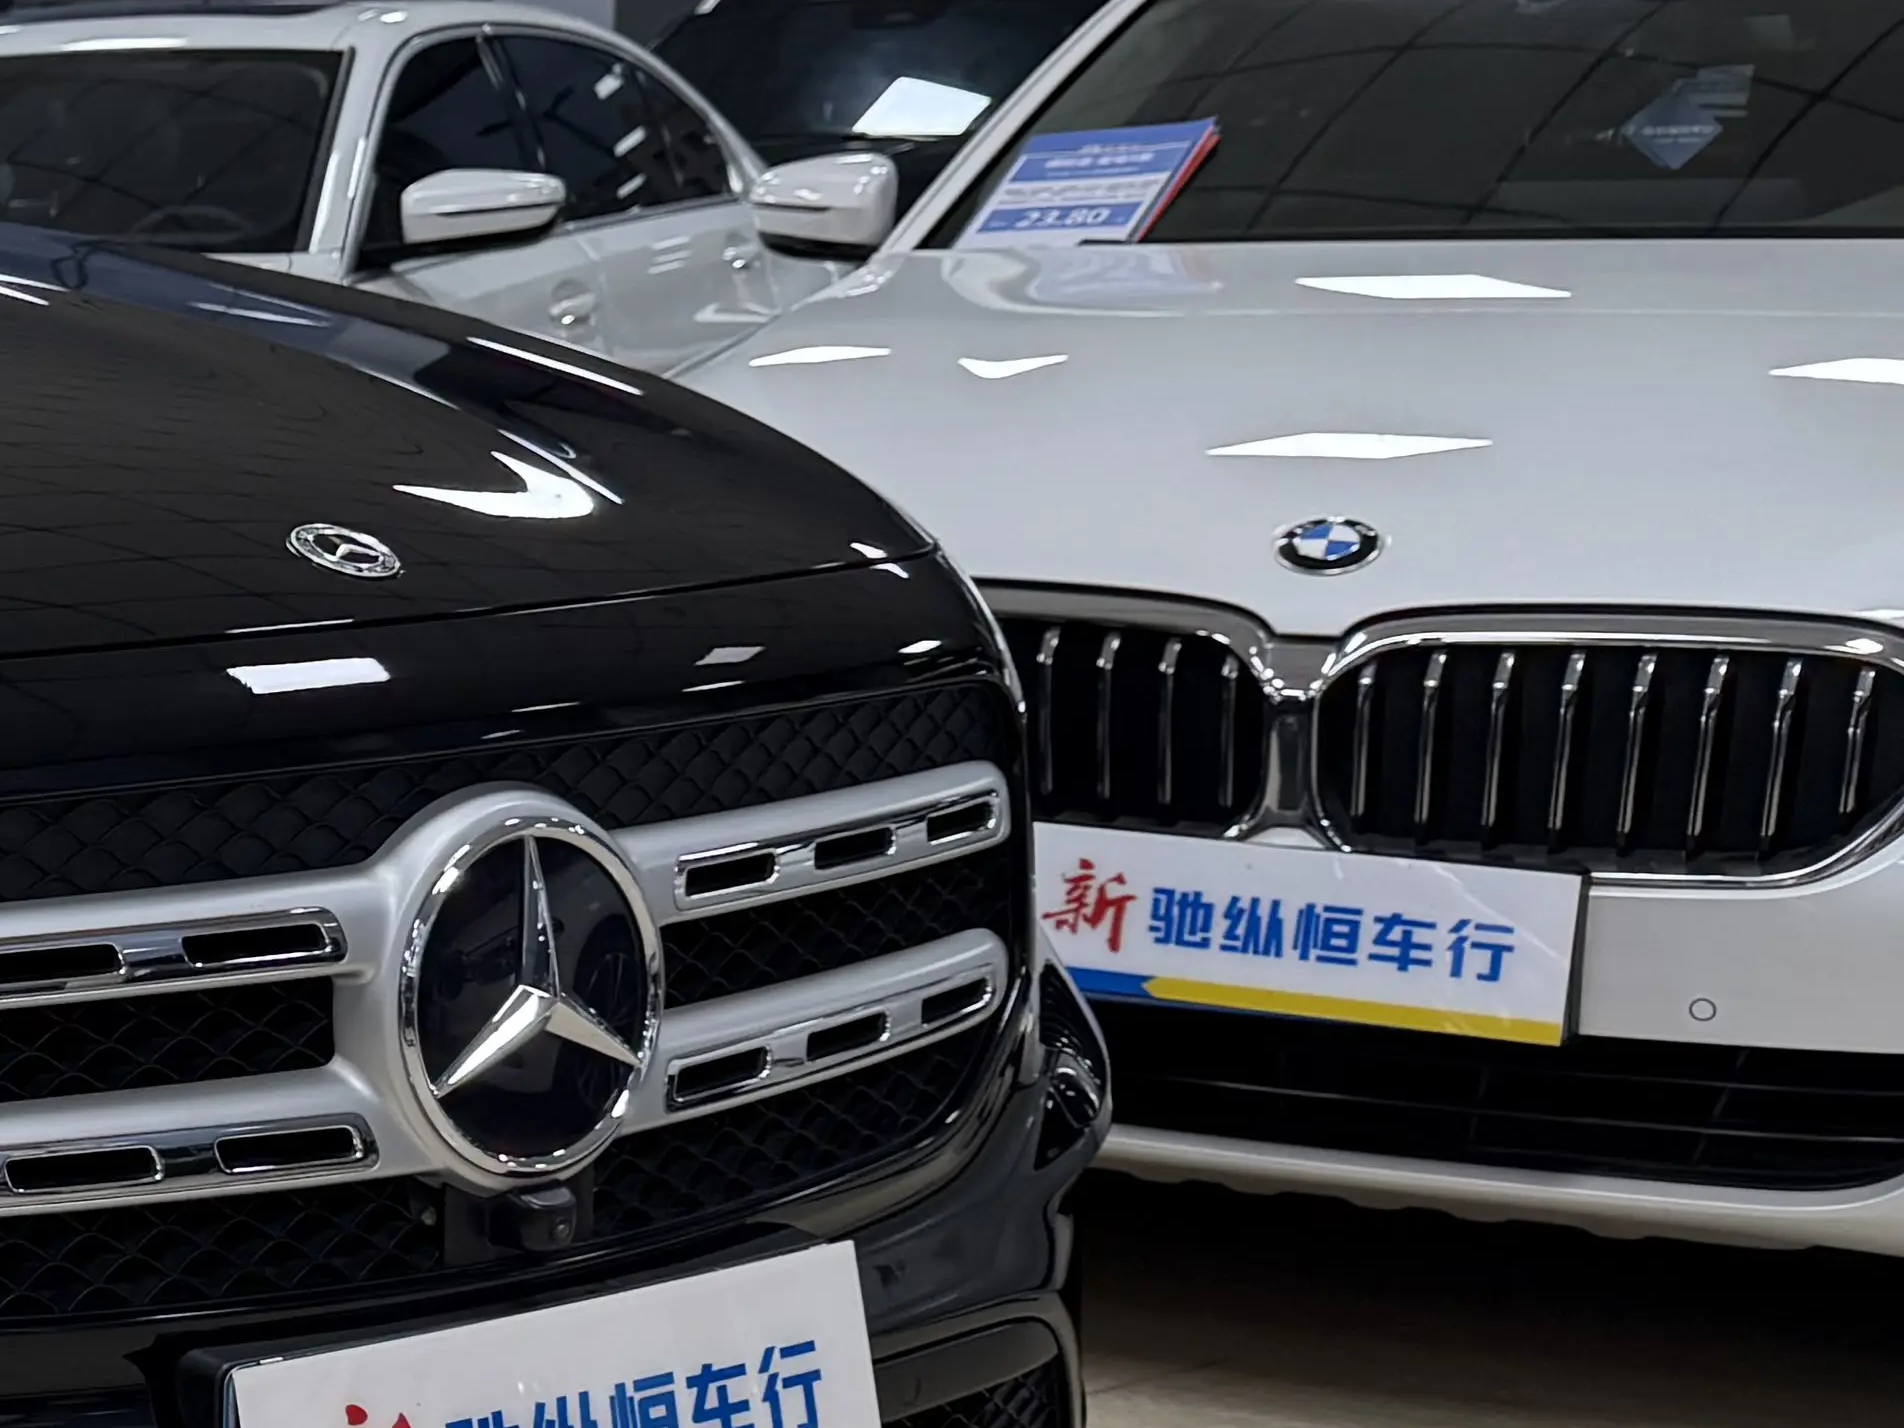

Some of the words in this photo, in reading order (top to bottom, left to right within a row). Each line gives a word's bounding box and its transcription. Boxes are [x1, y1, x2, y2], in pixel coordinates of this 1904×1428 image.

[1042, 857, 1515, 982] 新驰纵恒车行
